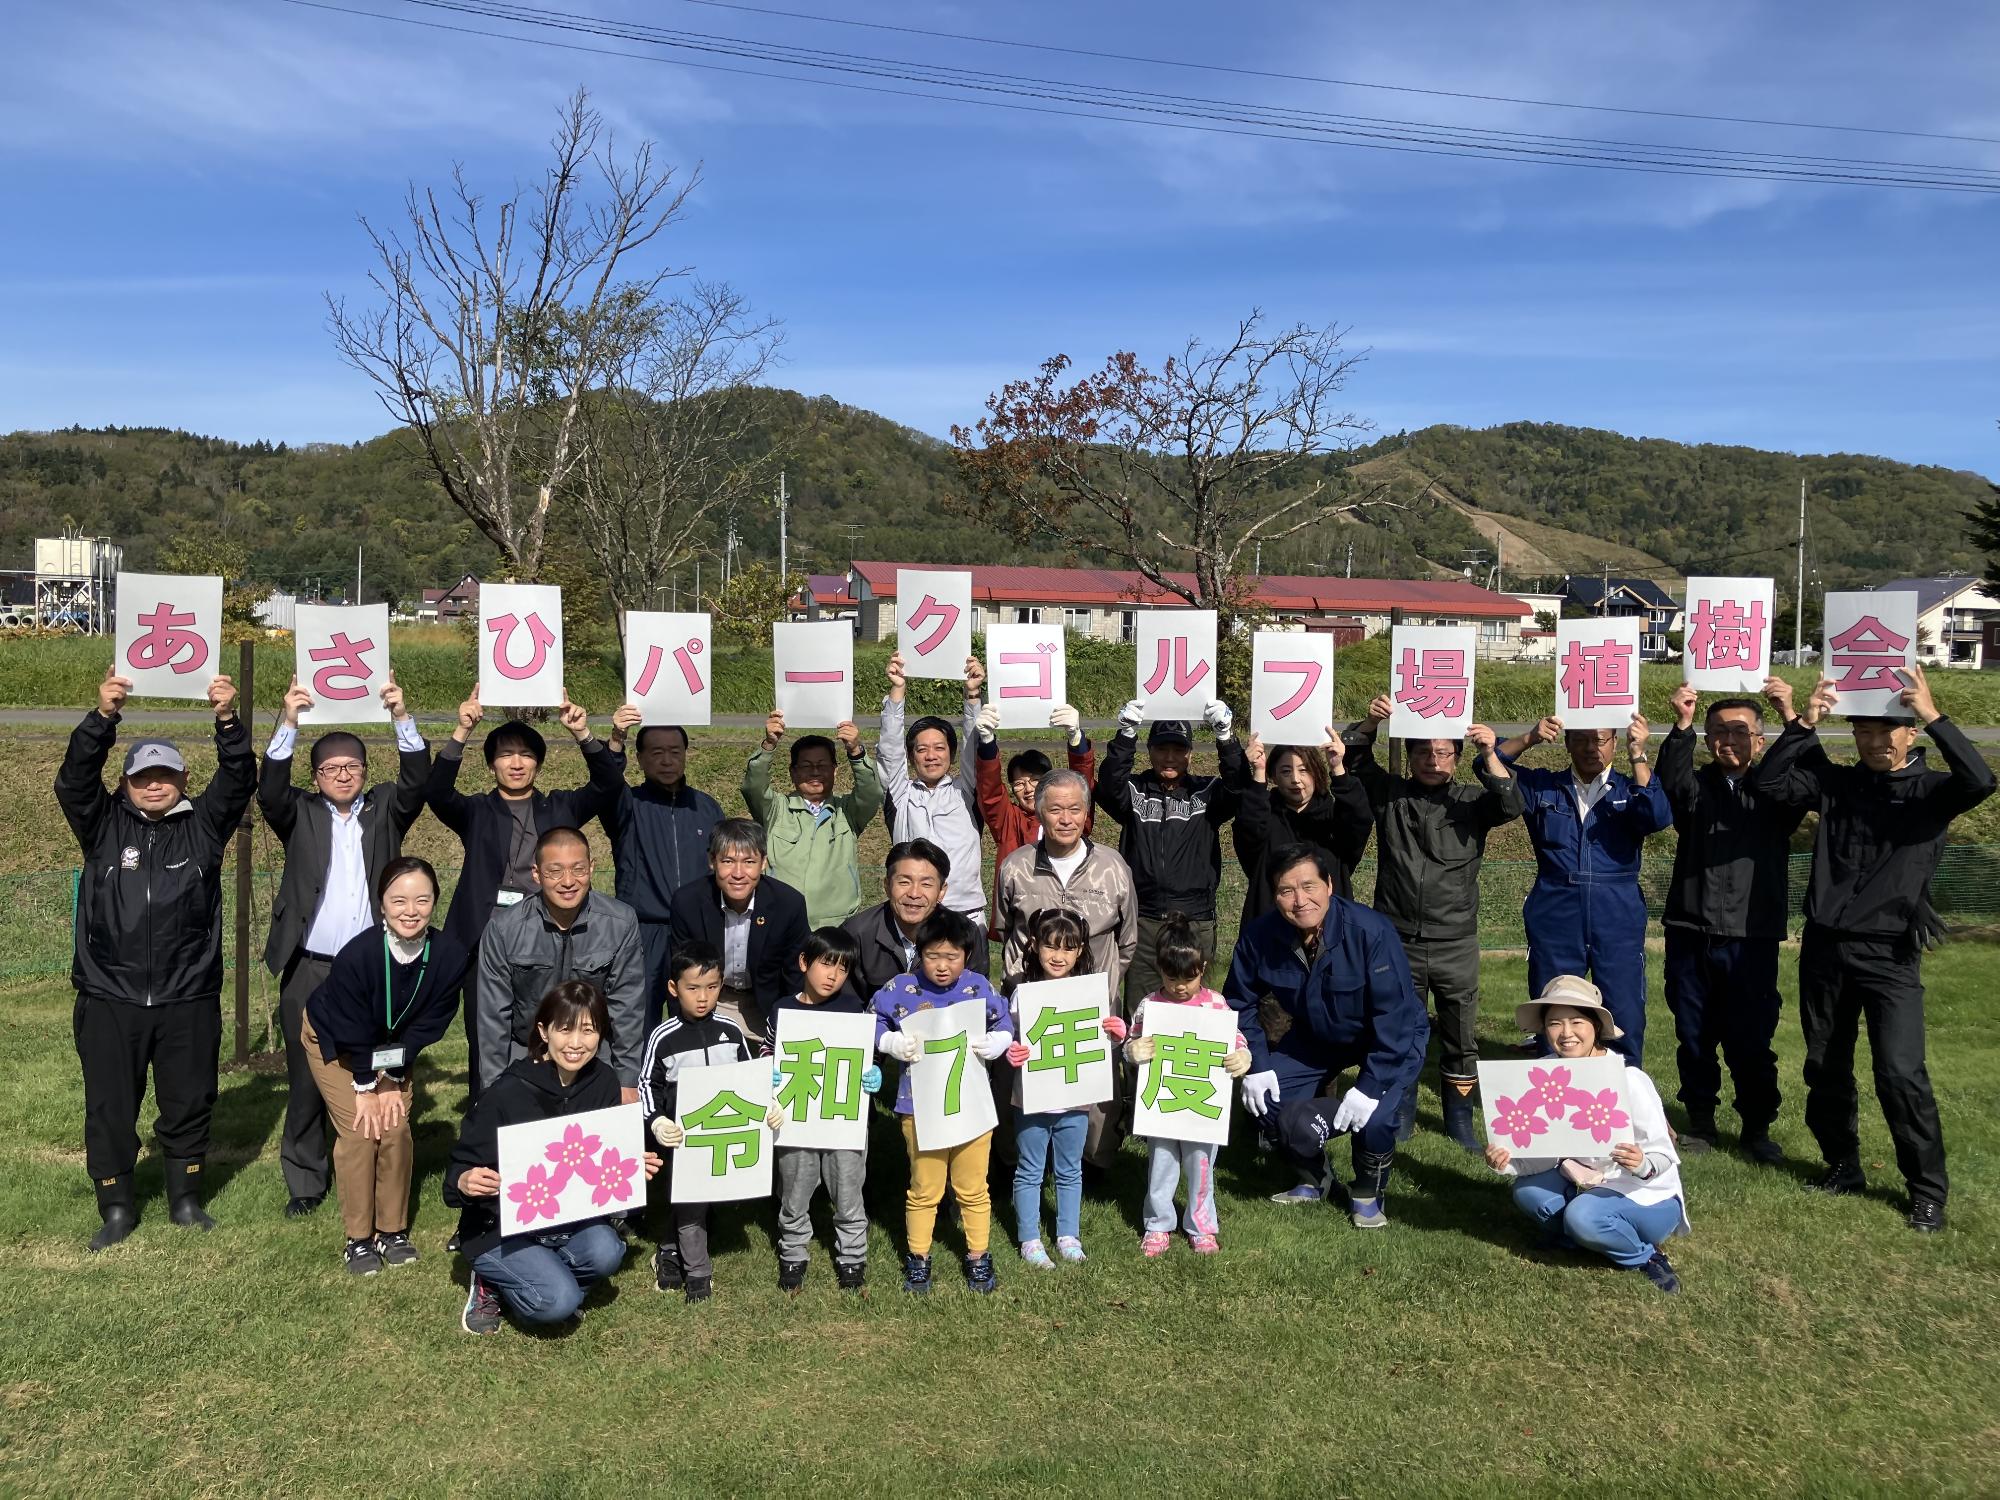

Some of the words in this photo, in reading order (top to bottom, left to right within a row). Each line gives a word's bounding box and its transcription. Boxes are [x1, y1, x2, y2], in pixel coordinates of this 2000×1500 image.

[126, 602, 209, 675] あ
[486, 612, 556, 681] ひ
[905, 594, 961, 656] ク
[1687, 599, 1767, 672] 樹
[1830, 615, 1909, 691] 会
[308, 632, 375, 701] さ
[633, 638, 704, 697] パ
[998, 642, 1058, 701] ゴ
[1143, 636, 1210, 697] ル
[1263, 661, 1323, 721] フ
[1394, 647, 1469, 719] 場
[1559, 639, 1634, 709] 植
[779, 1038, 866, 1122] 和
[924, 1030, 967, 1117] 7
[1026, 1007, 1106, 1084] 年
[1141, 1032, 1228, 1120] 度
[681, 1090, 767, 1177] 令
